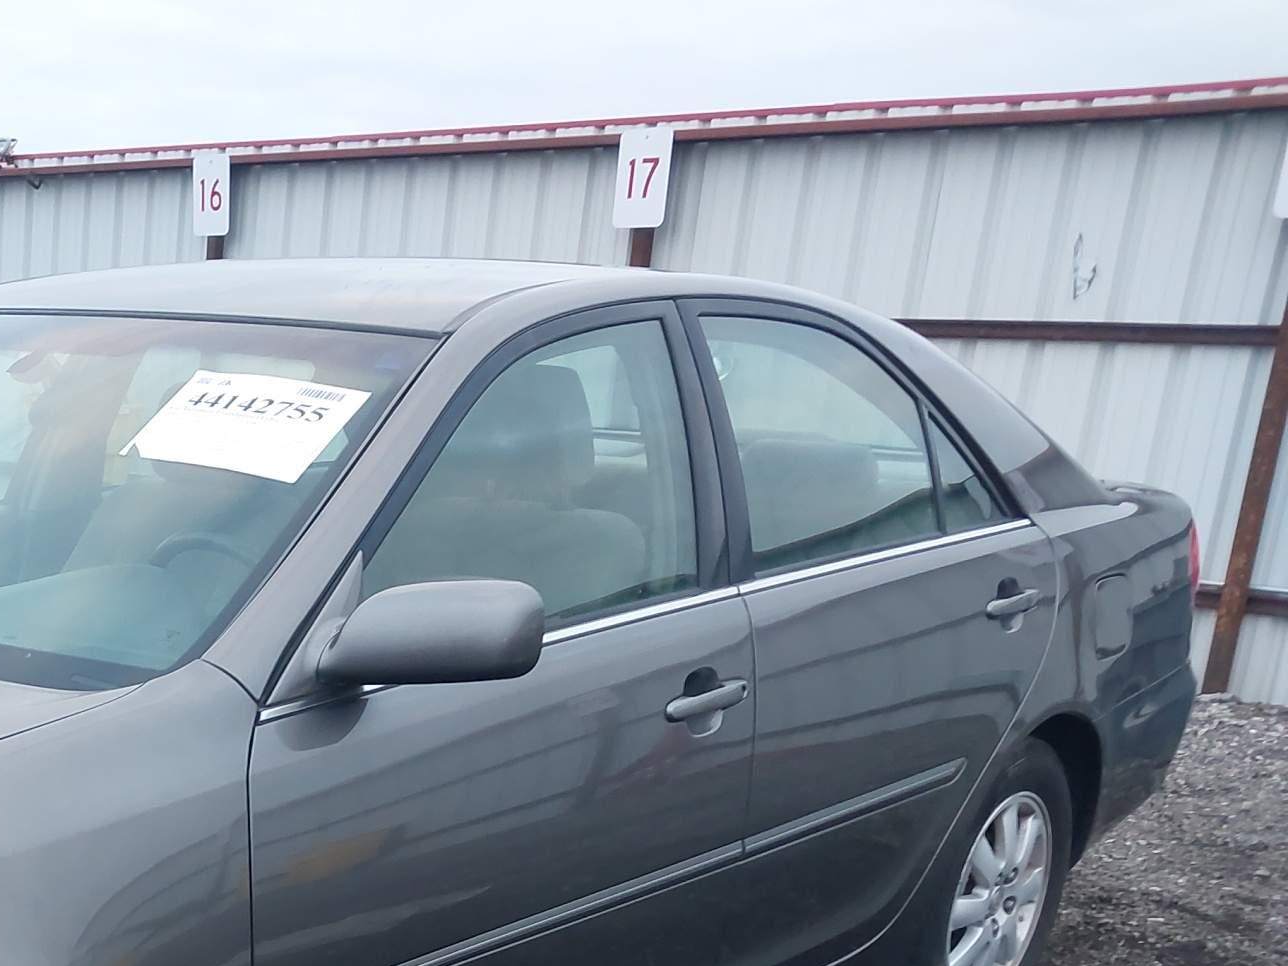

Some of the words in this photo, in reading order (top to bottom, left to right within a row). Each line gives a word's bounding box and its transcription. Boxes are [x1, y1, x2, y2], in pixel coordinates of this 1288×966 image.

[199, 178, 222, 212] 16
[627, 157, 660, 199] 17
[188, 391, 330, 423] 44142755
